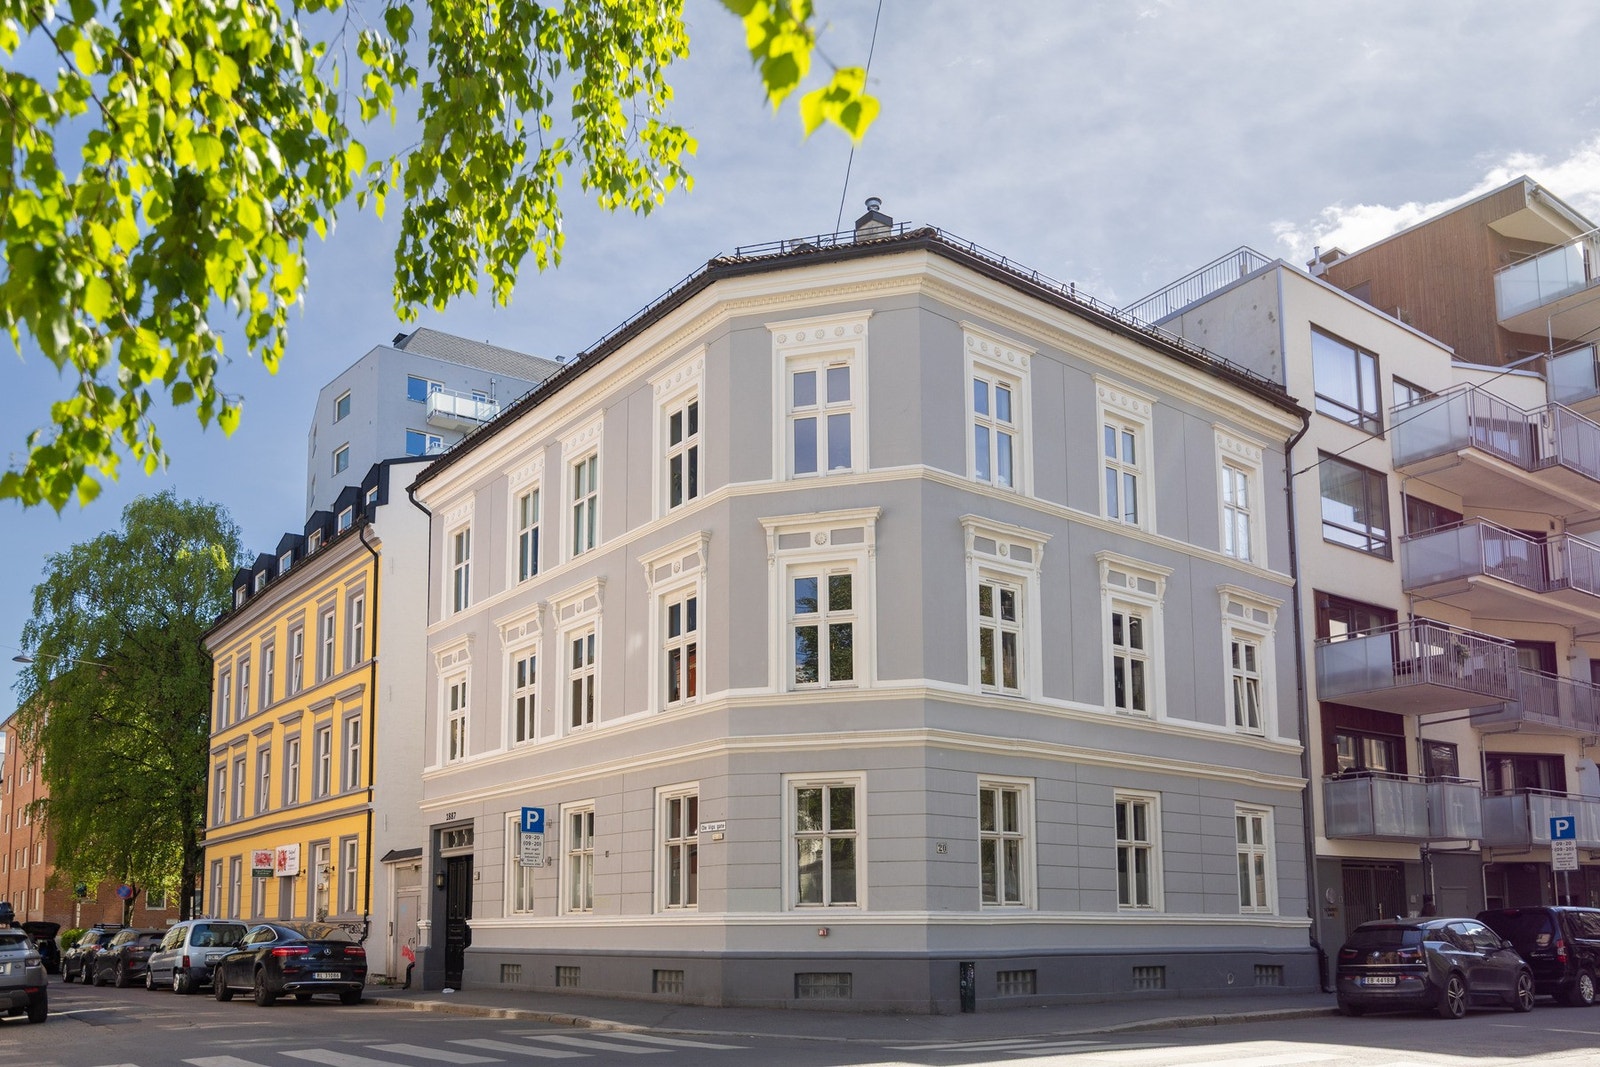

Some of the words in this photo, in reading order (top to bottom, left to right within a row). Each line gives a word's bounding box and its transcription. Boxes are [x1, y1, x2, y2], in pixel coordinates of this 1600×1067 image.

[446, 811, 456, 820] 1887
[527, 811, 539, 829] P
[1556, 820, 1569, 837] P
